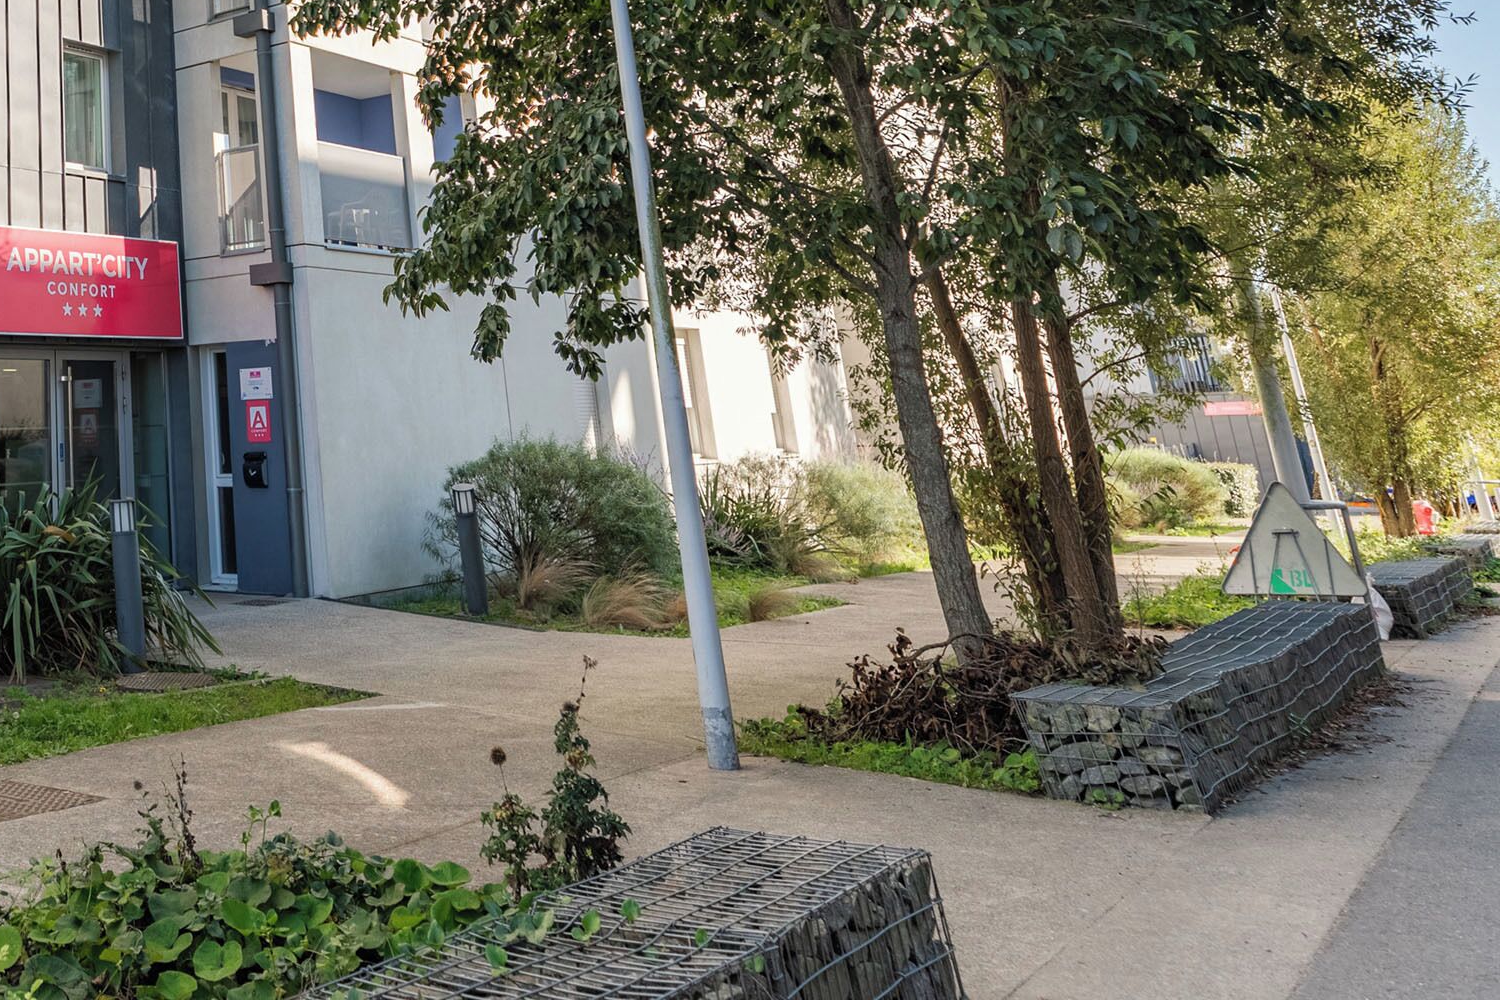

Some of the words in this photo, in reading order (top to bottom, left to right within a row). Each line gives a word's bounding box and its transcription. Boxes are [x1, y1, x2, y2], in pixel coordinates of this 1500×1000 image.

[6, 246, 149, 280] APPART'CITY
[47, 281, 116, 298] CONFORT
[252, 410, 267, 429] A
